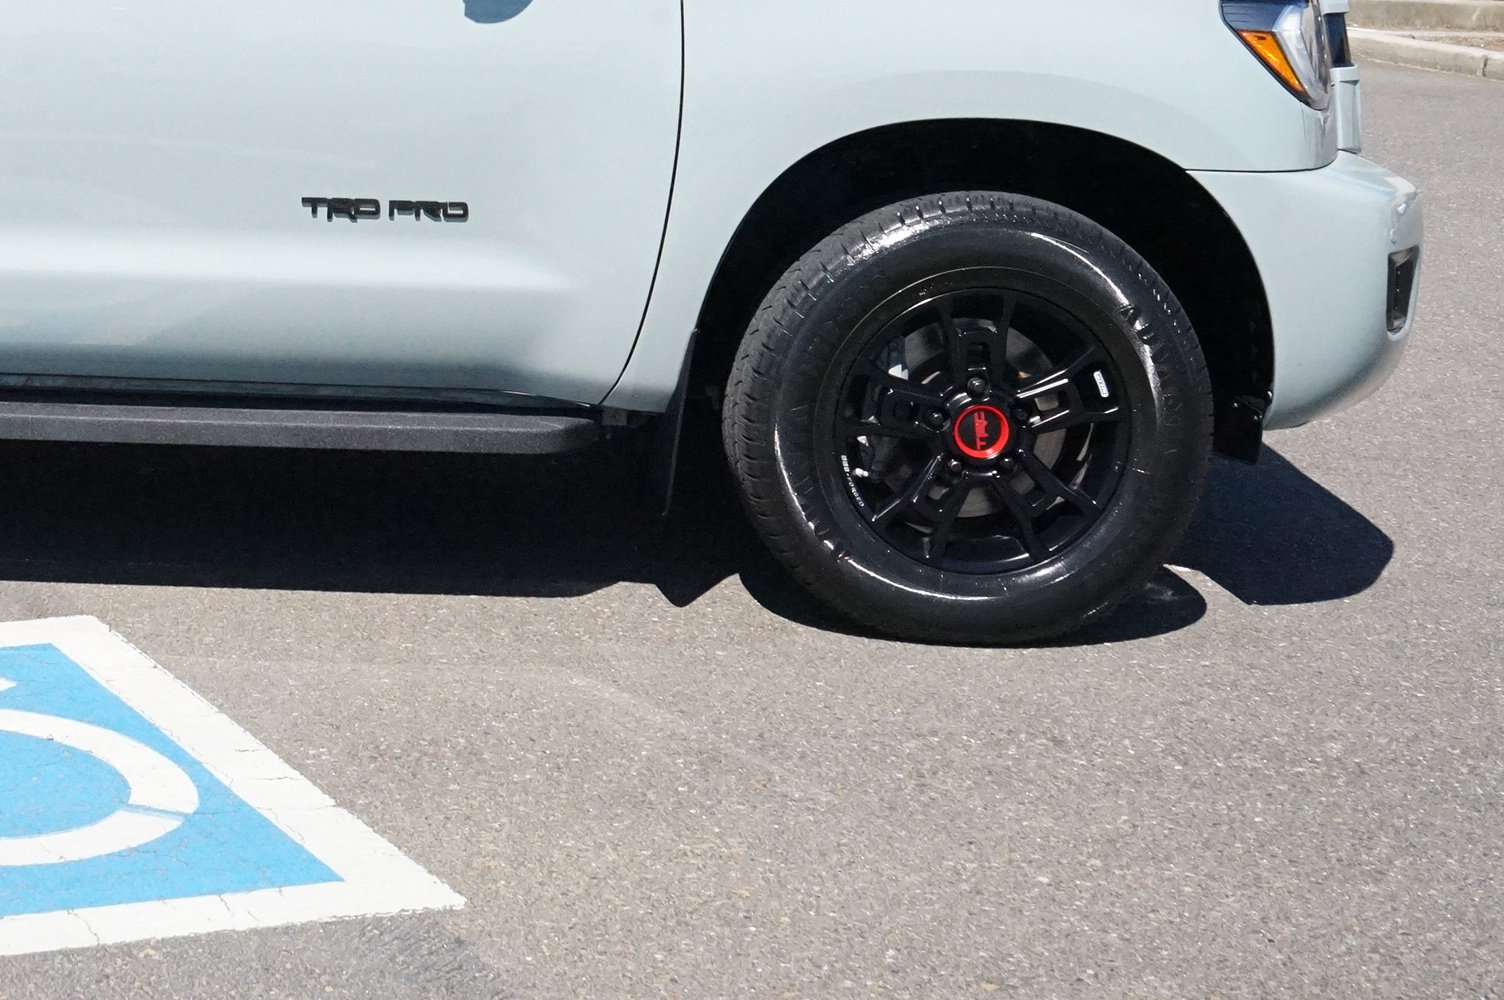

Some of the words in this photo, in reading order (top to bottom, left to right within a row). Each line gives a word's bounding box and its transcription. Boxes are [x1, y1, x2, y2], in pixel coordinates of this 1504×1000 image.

[301, 197, 381, 223] TRD
[389, 200, 469, 222] PRO
[974, 411, 989, 450] TRD
